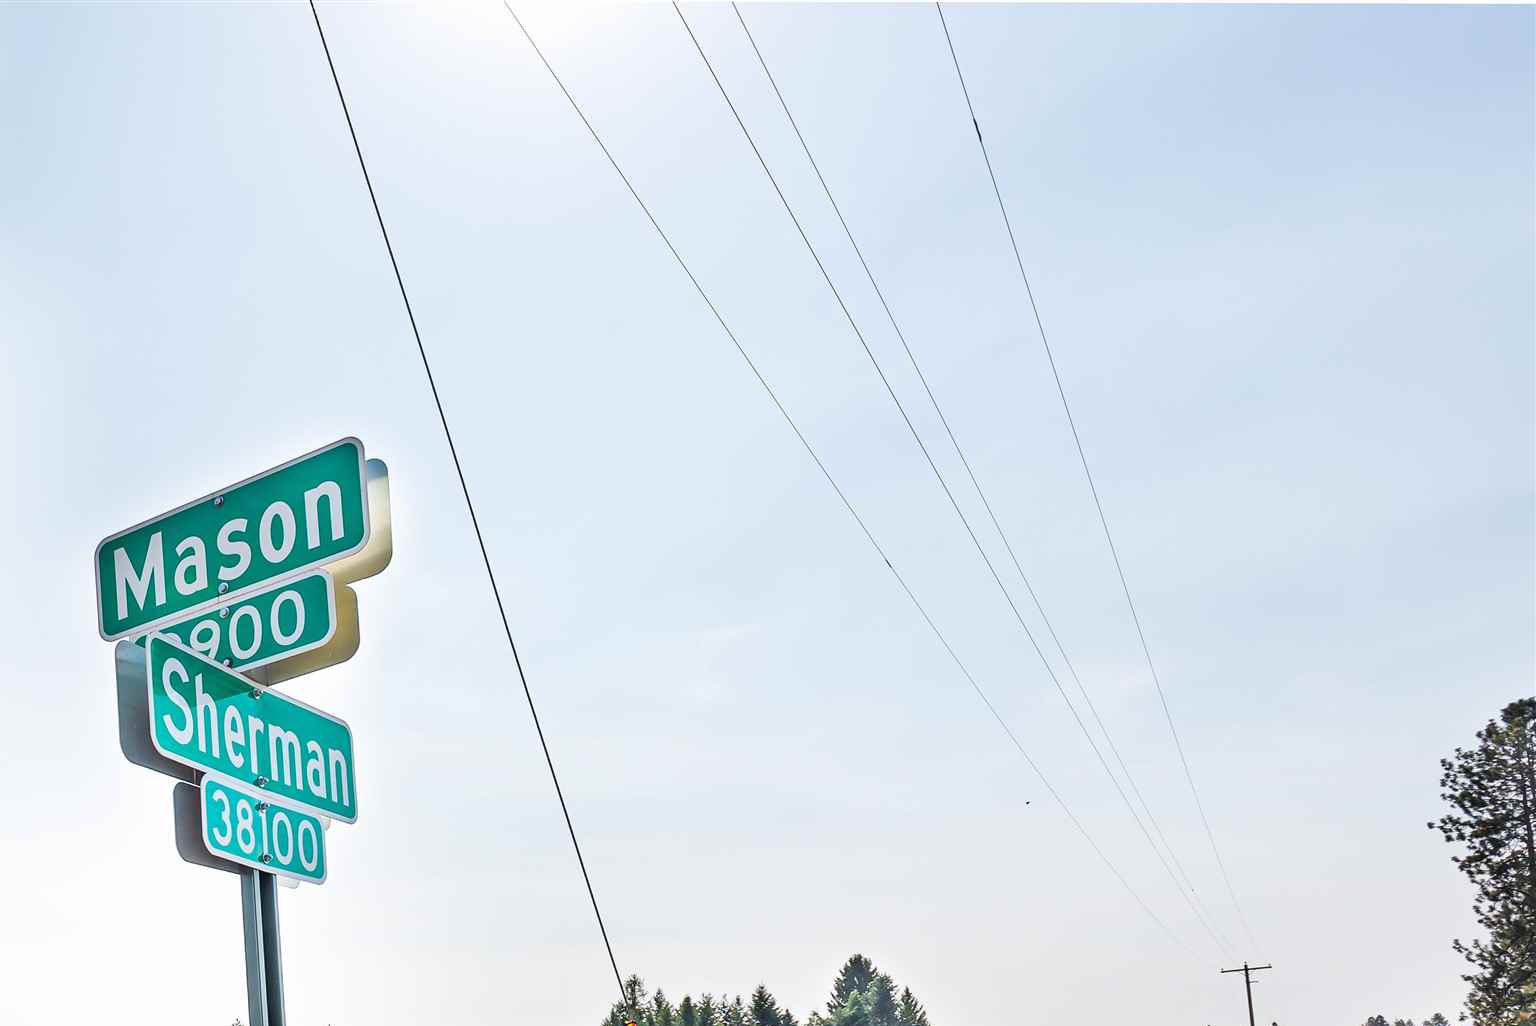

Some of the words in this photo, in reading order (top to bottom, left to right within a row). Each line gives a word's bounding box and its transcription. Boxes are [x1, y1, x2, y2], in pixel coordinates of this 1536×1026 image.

[113, 479, 345, 622] Mason
[166, 590, 305, 660] 900
[163, 657, 350, 807] Sherman
[213, 789, 318, 872] 38100
